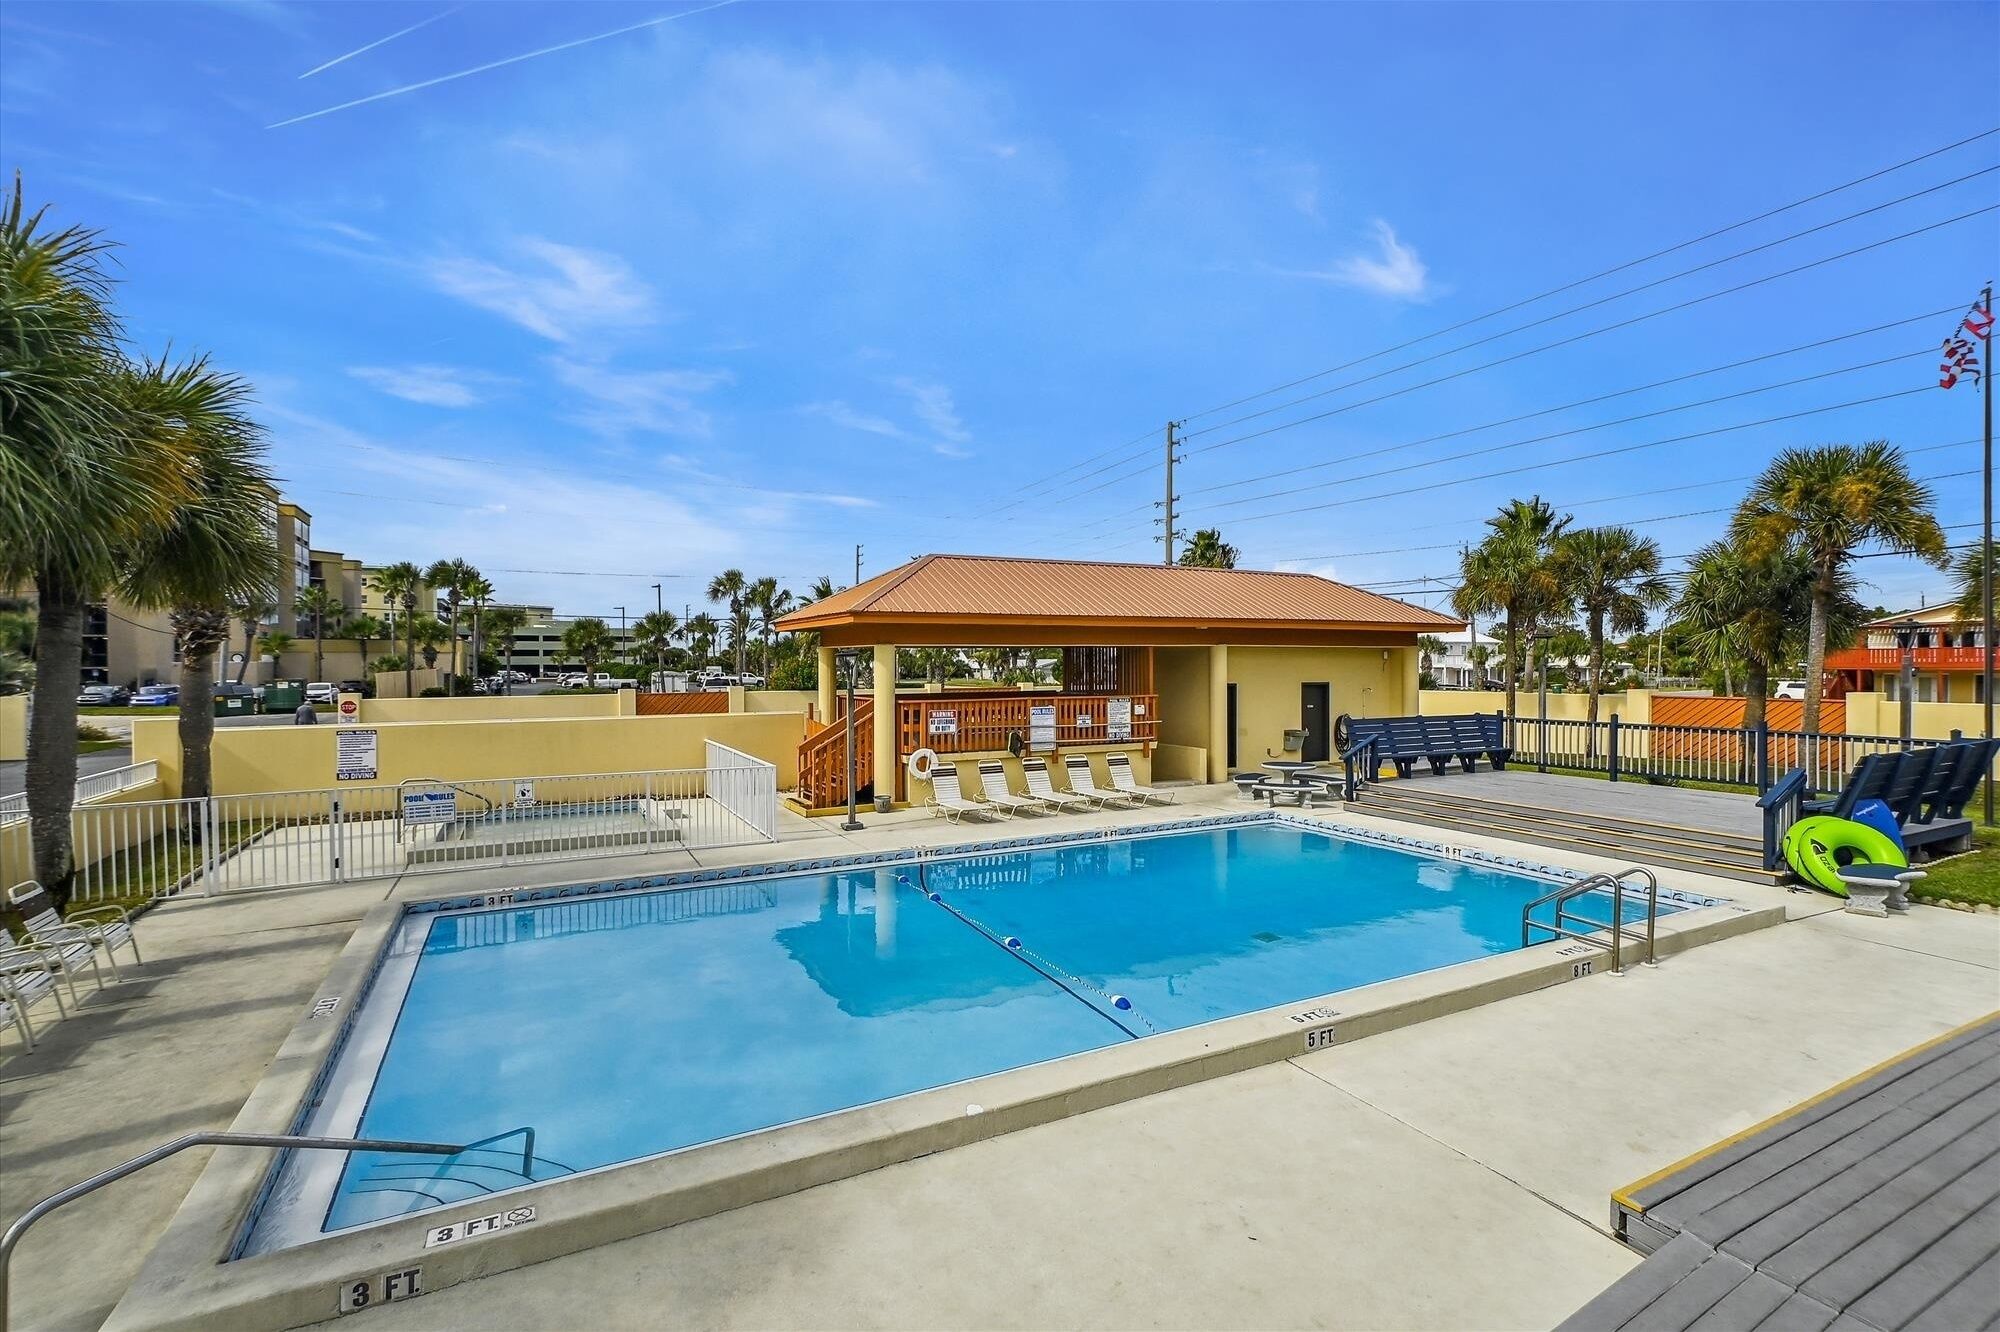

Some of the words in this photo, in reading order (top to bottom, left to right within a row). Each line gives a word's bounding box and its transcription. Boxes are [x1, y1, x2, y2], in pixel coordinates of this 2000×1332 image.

[932, 710, 954, 718] WARNING
[488, 896, 495, 906] 3
[500, 894, 513, 904] FT
[1573, 964, 1579, 978] 8
[1290, 1015, 1305, 1023] 5
[1308, 1031, 1316, 1048] 5
[1320, 1028, 1334, 1046] FT.
[437, 1227, 454, 1243] 3
[467, 1215, 499, 1236] FT.
[352, 1282, 370, 1308] 3
[386, 1268, 421, 1301] FT.
